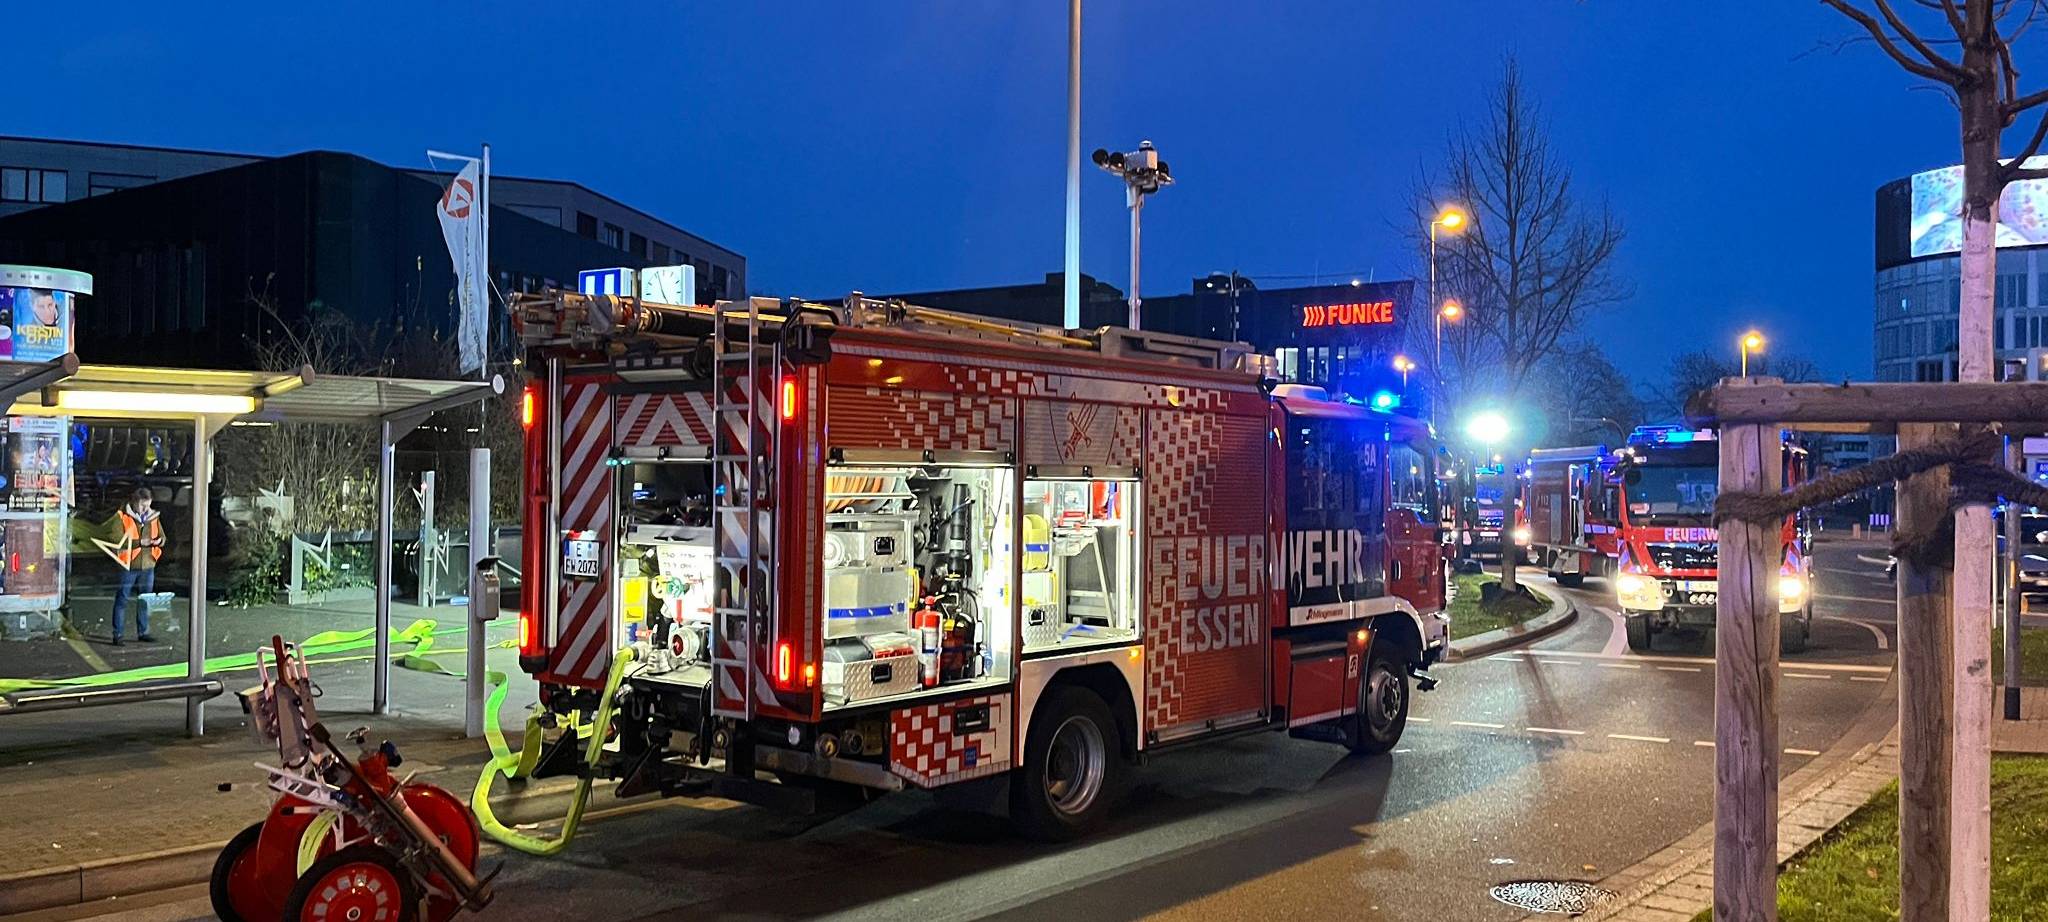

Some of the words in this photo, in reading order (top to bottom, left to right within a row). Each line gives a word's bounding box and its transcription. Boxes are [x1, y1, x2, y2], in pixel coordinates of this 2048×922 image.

[1327, 302, 1393, 325] FUNKE
[1364, 443, 1377, 467] 5A
[1664, 527, 1718, 542] FEUERW
[576, 542, 582, 557] E
[566, 558, 576, 573] FW
[578, 559, 598, 575] 2073
[1152, 529, 1364, 604] FEUERWEHR
[1180, 603, 1259, 655] ESSEN
